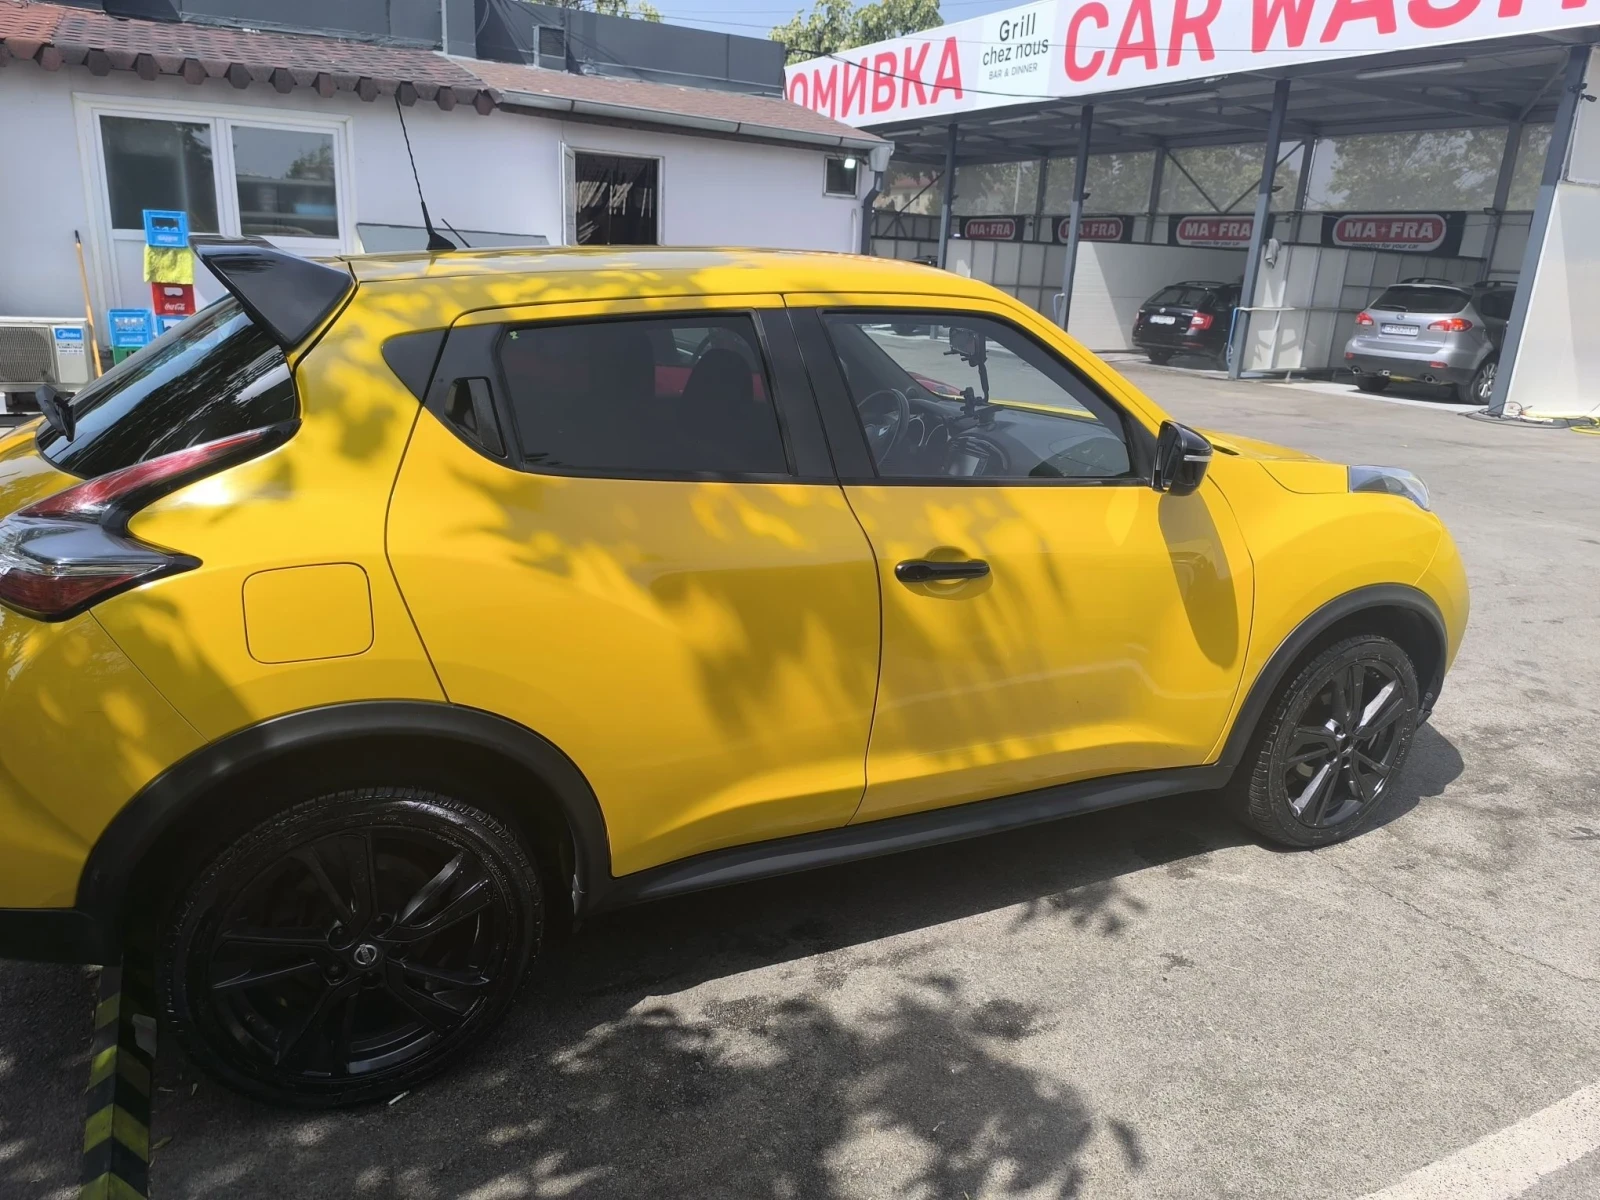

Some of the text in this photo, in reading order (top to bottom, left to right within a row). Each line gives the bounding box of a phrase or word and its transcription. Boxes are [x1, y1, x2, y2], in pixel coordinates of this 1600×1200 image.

[1000, 12, 1036, 42] Grill
[1064, 0, 1221, 82] CAR
[982, 39, 1049, 66] chez nous
[787, 36, 963, 120] ОМИВКА
[988, 62, 1038, 80] BAR & DINNER
